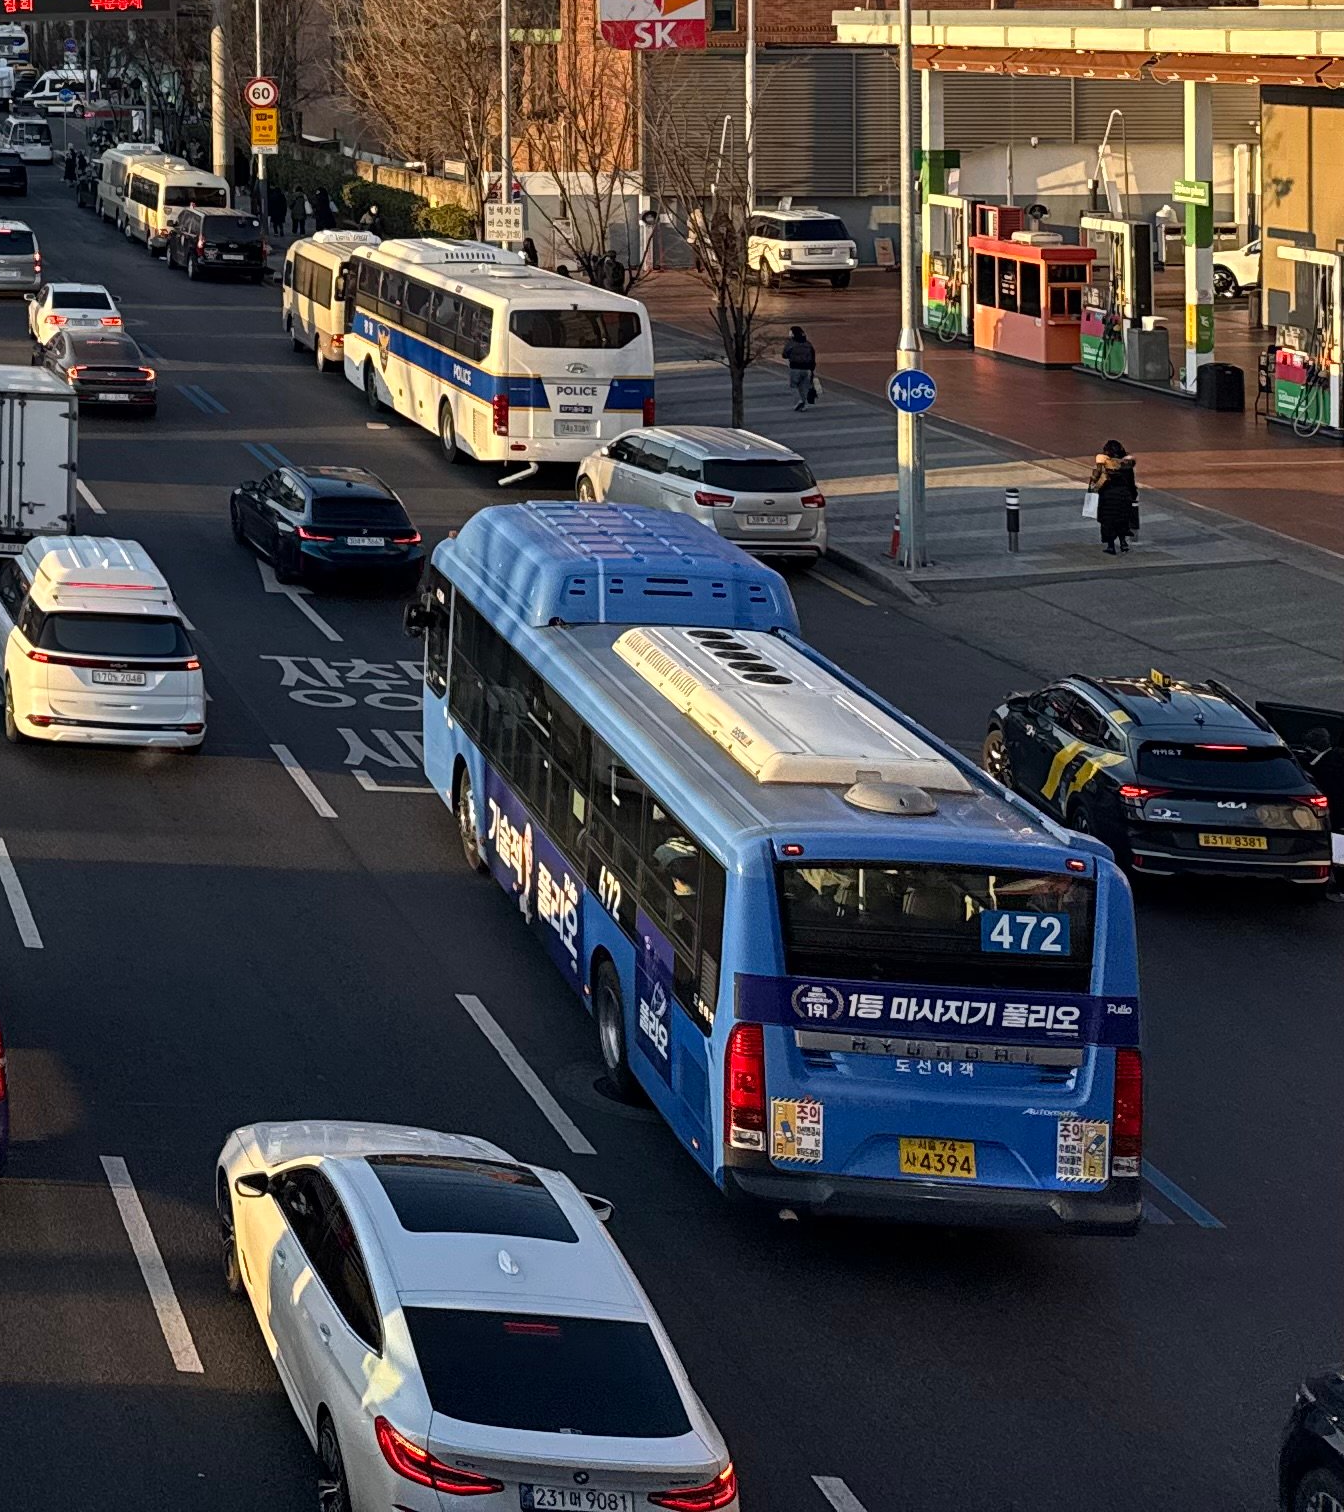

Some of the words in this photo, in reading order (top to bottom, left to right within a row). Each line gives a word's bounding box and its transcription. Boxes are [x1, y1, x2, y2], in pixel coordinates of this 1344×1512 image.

[634, 22, 677, 49] SK
[252, 88, 270, 100] 60
[488, 218, 521, 228] 버스전용
[453, 364, 472, 386] POLICE
[557, 386, 598, 396] POLICE
[1235, 837, 1264, 848] 8381
[989, 913, 1063, 952] 472
[807, 1004, 828, 1018] 1위
[848, 994, 883, 1019] 1등
[890, 998, 996, 1026] 마사지기
[1001, 1003, 1080, 1030] 풀리오
[639, 997, 669, 1060] 풀리오
[852, 1038, 1032, 1063] HYUNDAI
[797, 1105, 820, 1125] 주의
[1060, 1124, 1083, 1142] 주의
[585, 1490, 628, 1511] 9081
